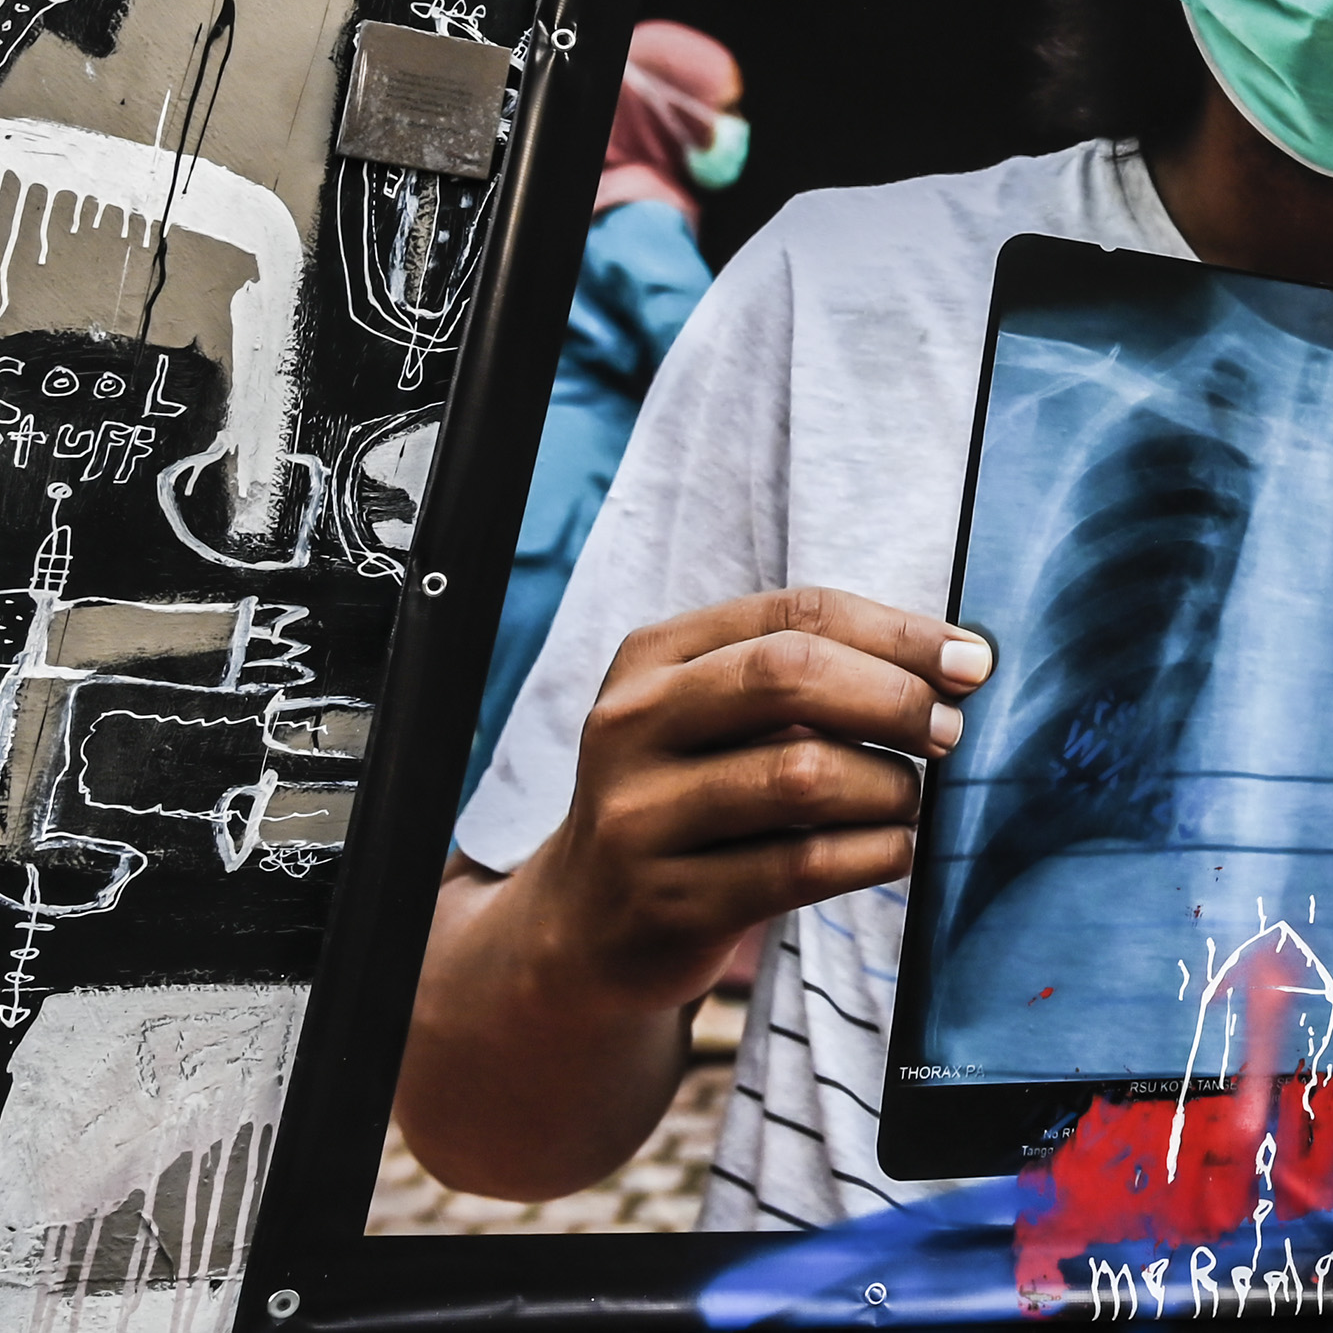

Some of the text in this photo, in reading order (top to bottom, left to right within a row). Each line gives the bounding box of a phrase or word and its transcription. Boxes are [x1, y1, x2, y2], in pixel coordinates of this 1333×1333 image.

[899, 1064, 985, 1080] THORAX PA
[1130, 1081, 1158, 1094] RSU
